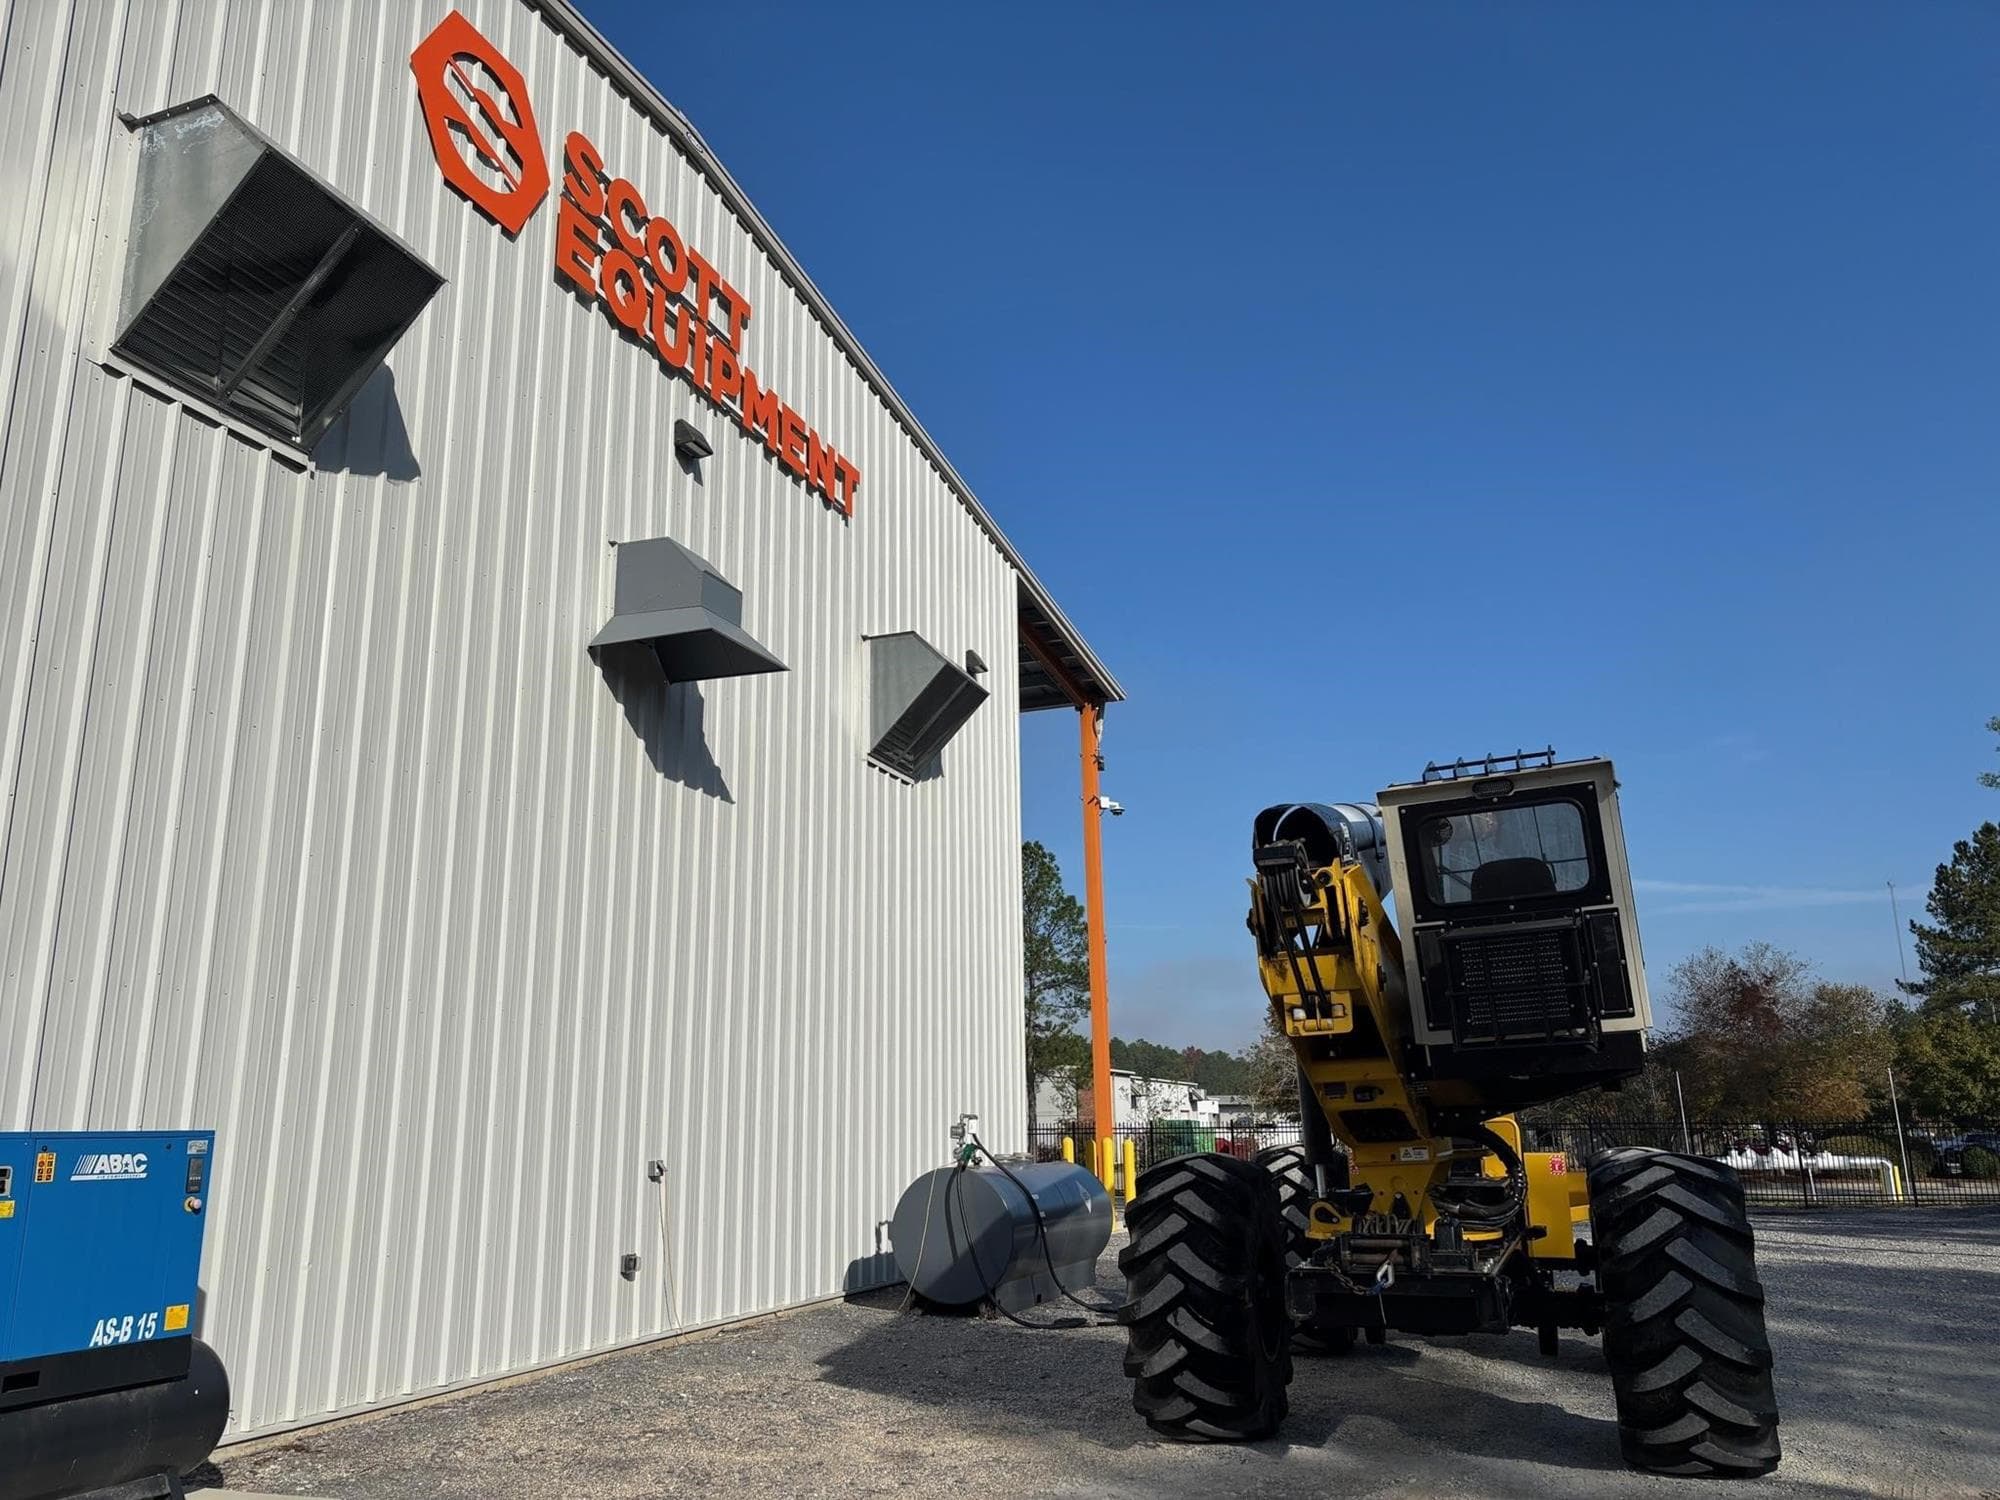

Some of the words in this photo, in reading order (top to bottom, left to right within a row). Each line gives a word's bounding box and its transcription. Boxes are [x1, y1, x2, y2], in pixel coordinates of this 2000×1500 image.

[564, 131, 752, 354] SCOTT
[556, 195, 860, 518] EQUIPMENT
[93, 1153, 148, 1174] ABAC
[89, 1315, 134, 1347] AS-B
[137, 1312, 158, 1340] 15
